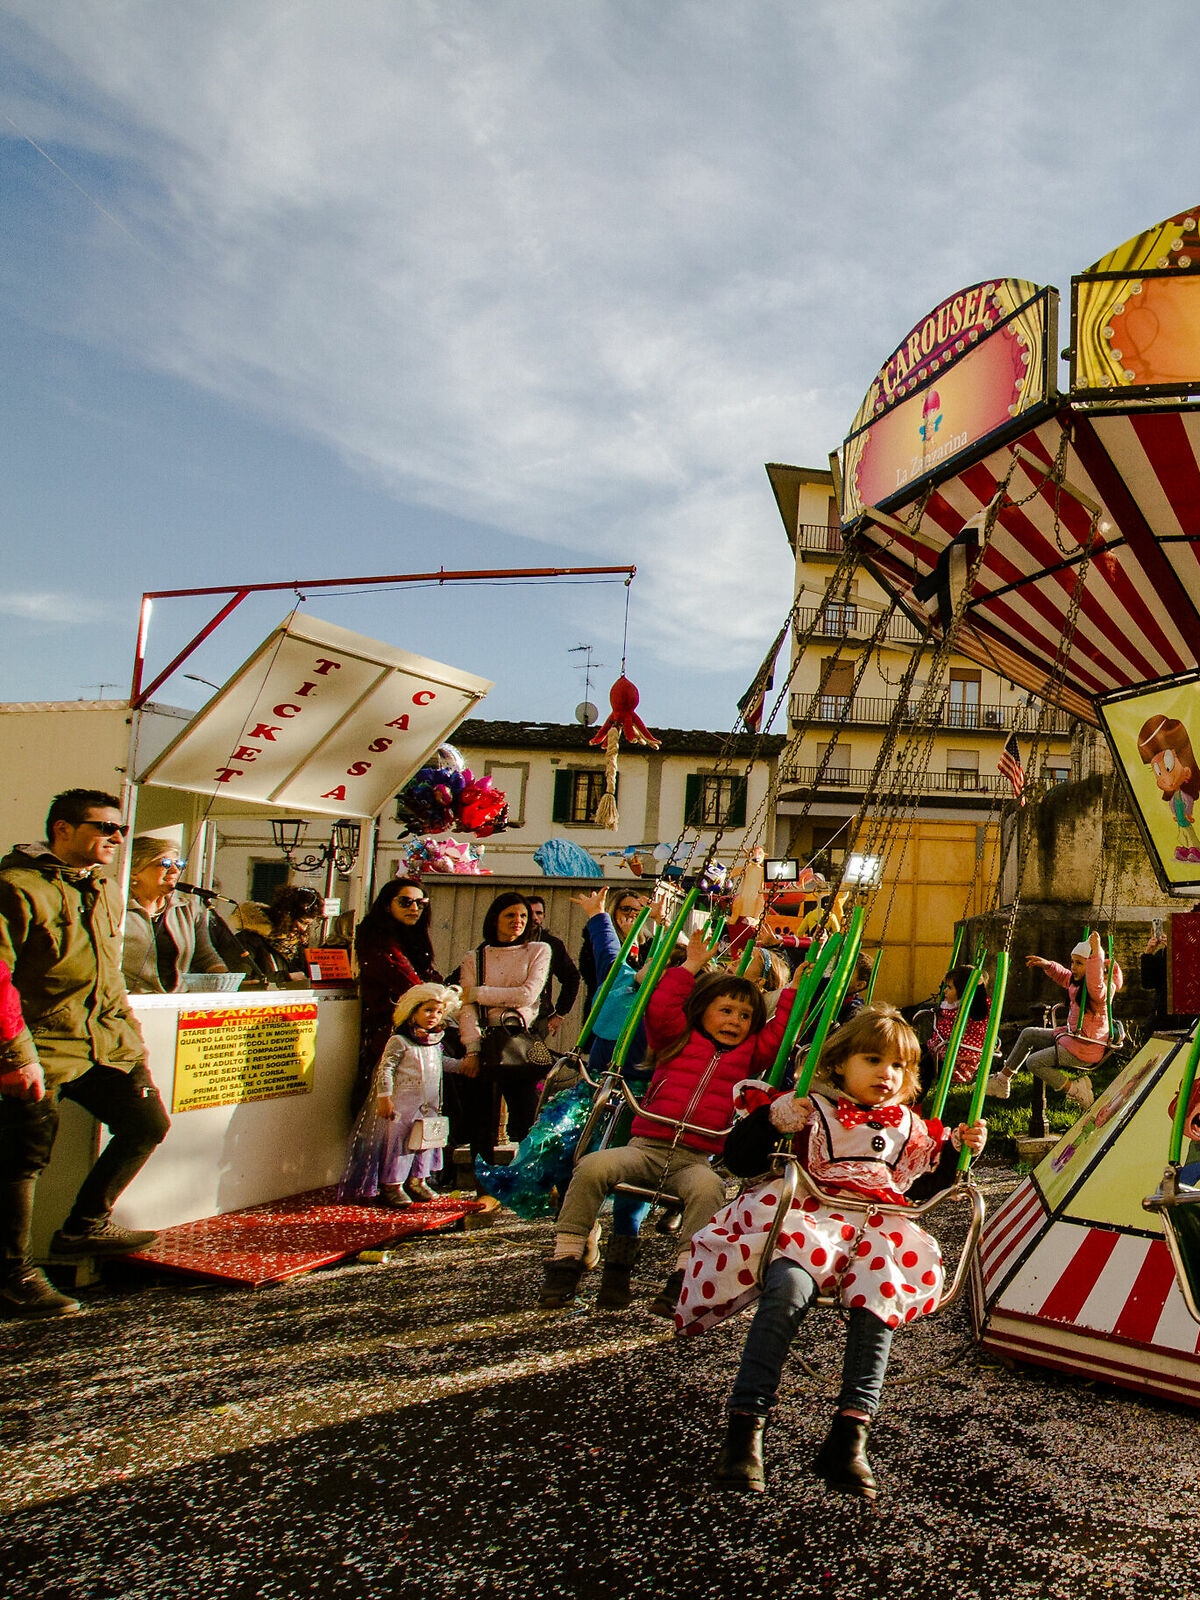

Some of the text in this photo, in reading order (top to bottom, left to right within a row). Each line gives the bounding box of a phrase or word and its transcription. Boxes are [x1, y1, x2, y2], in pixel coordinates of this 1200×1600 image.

[882, 285, 993, 395] CAROUSEL
[895, 431, 968, 487] La Zanzarina
[214, 658, 341, 783] TICKET
[320, 690, 436, 801] CASSA
[183, 1004, 315, 1020] LA ZANZARINA
[222, 1015, 283, 1027] ATTENZIONE
[183, 1029, 207, 1037] STARE
[209, 1026, 236, 1034] DIETRO
[180, 1037, 212, 1046] QUANDO
[226, 1033, 255, 1041] GIOSTRA
[203, 1043, 237, 1052] BAMBINI
[239, 1039, 268, 1048] PICCOLI
[204, 1045, 294, 1060] ESSERE ACCOMPAGNATI
[213, 1058, 244, 1067] ADULTO
[193, 1070, 218, 1078] STARE
[221, 1065, 249, 1075] SEDUTI
[209, 1074, 246, 1084] DURANTE
[193, 1086, 218, 1094] PRIMA
[179, 1094, 220, 1105] ASPETTARE
